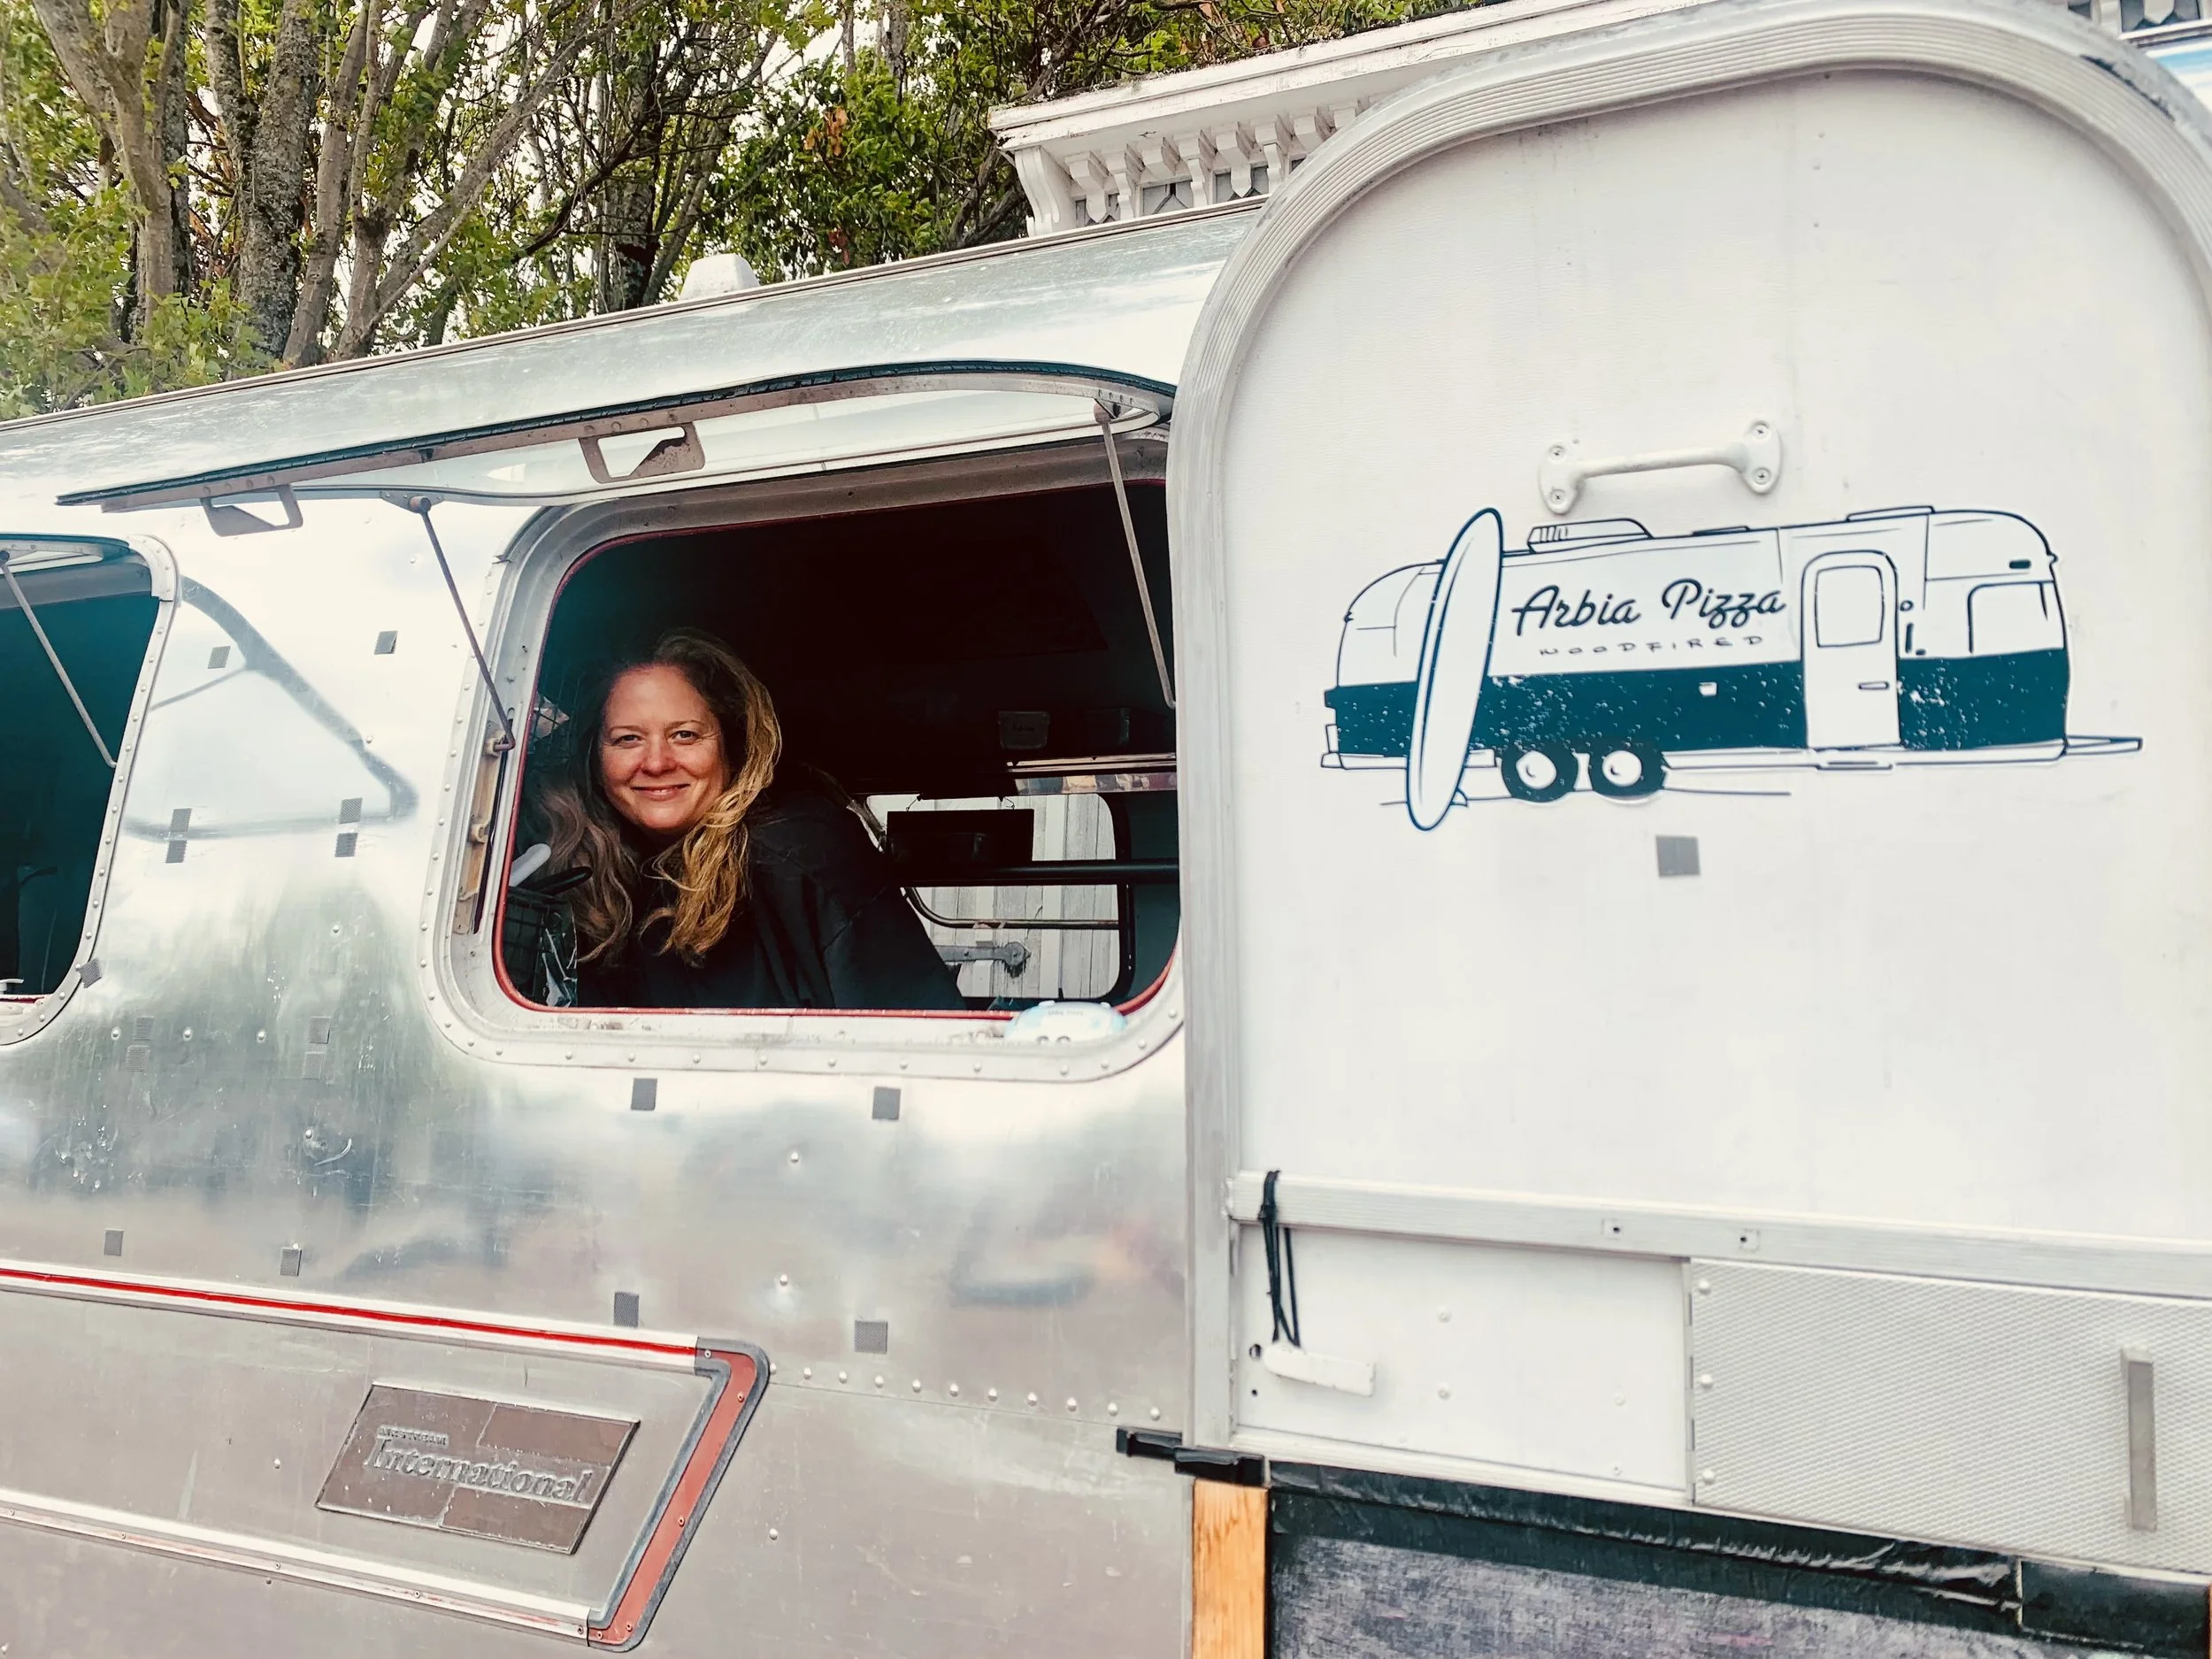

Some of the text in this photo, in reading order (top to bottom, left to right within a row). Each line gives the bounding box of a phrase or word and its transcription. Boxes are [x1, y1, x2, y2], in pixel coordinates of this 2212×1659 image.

[1511, 577, 1786, 636] Arbia Pizza
[1539, 635, 1763, 656] WOODFIRED
[364, 1437, 594, 1502] International
